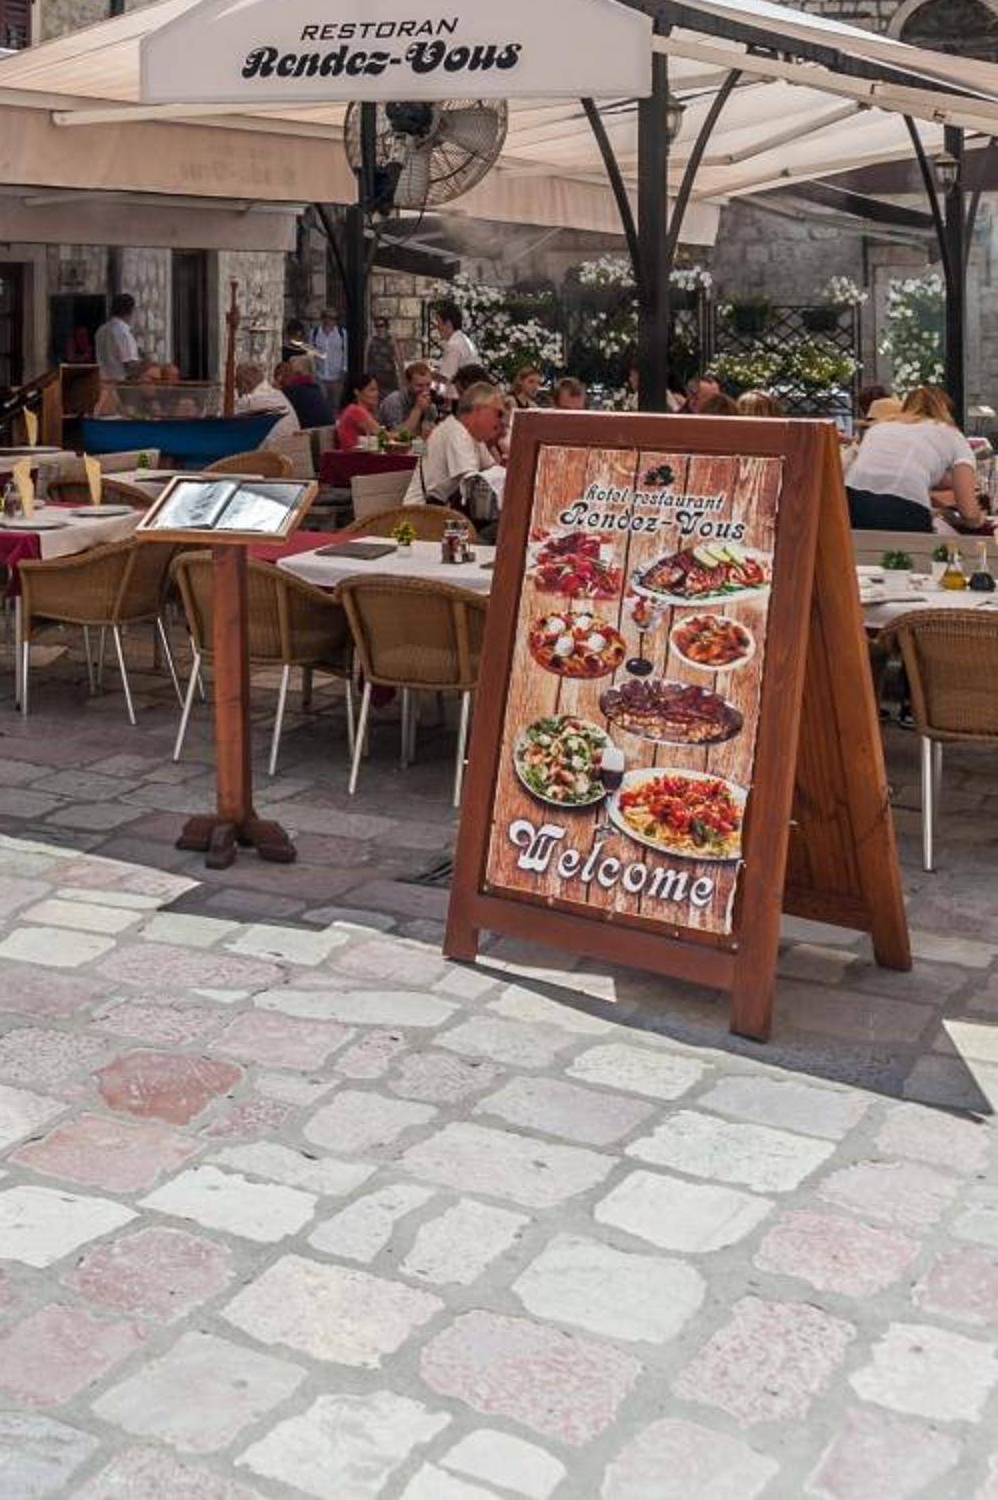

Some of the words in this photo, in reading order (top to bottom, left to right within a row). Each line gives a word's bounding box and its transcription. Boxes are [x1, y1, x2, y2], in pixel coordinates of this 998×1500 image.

[300, 17, 459, 41] RESTORAN
[241, 40, 522, 79] Rendez-Vous
[632, 488, 725, 510] restaurant
[559, 501, 746, 540] Rendez-Vous
[508, 818, 716, 907] Welcome
